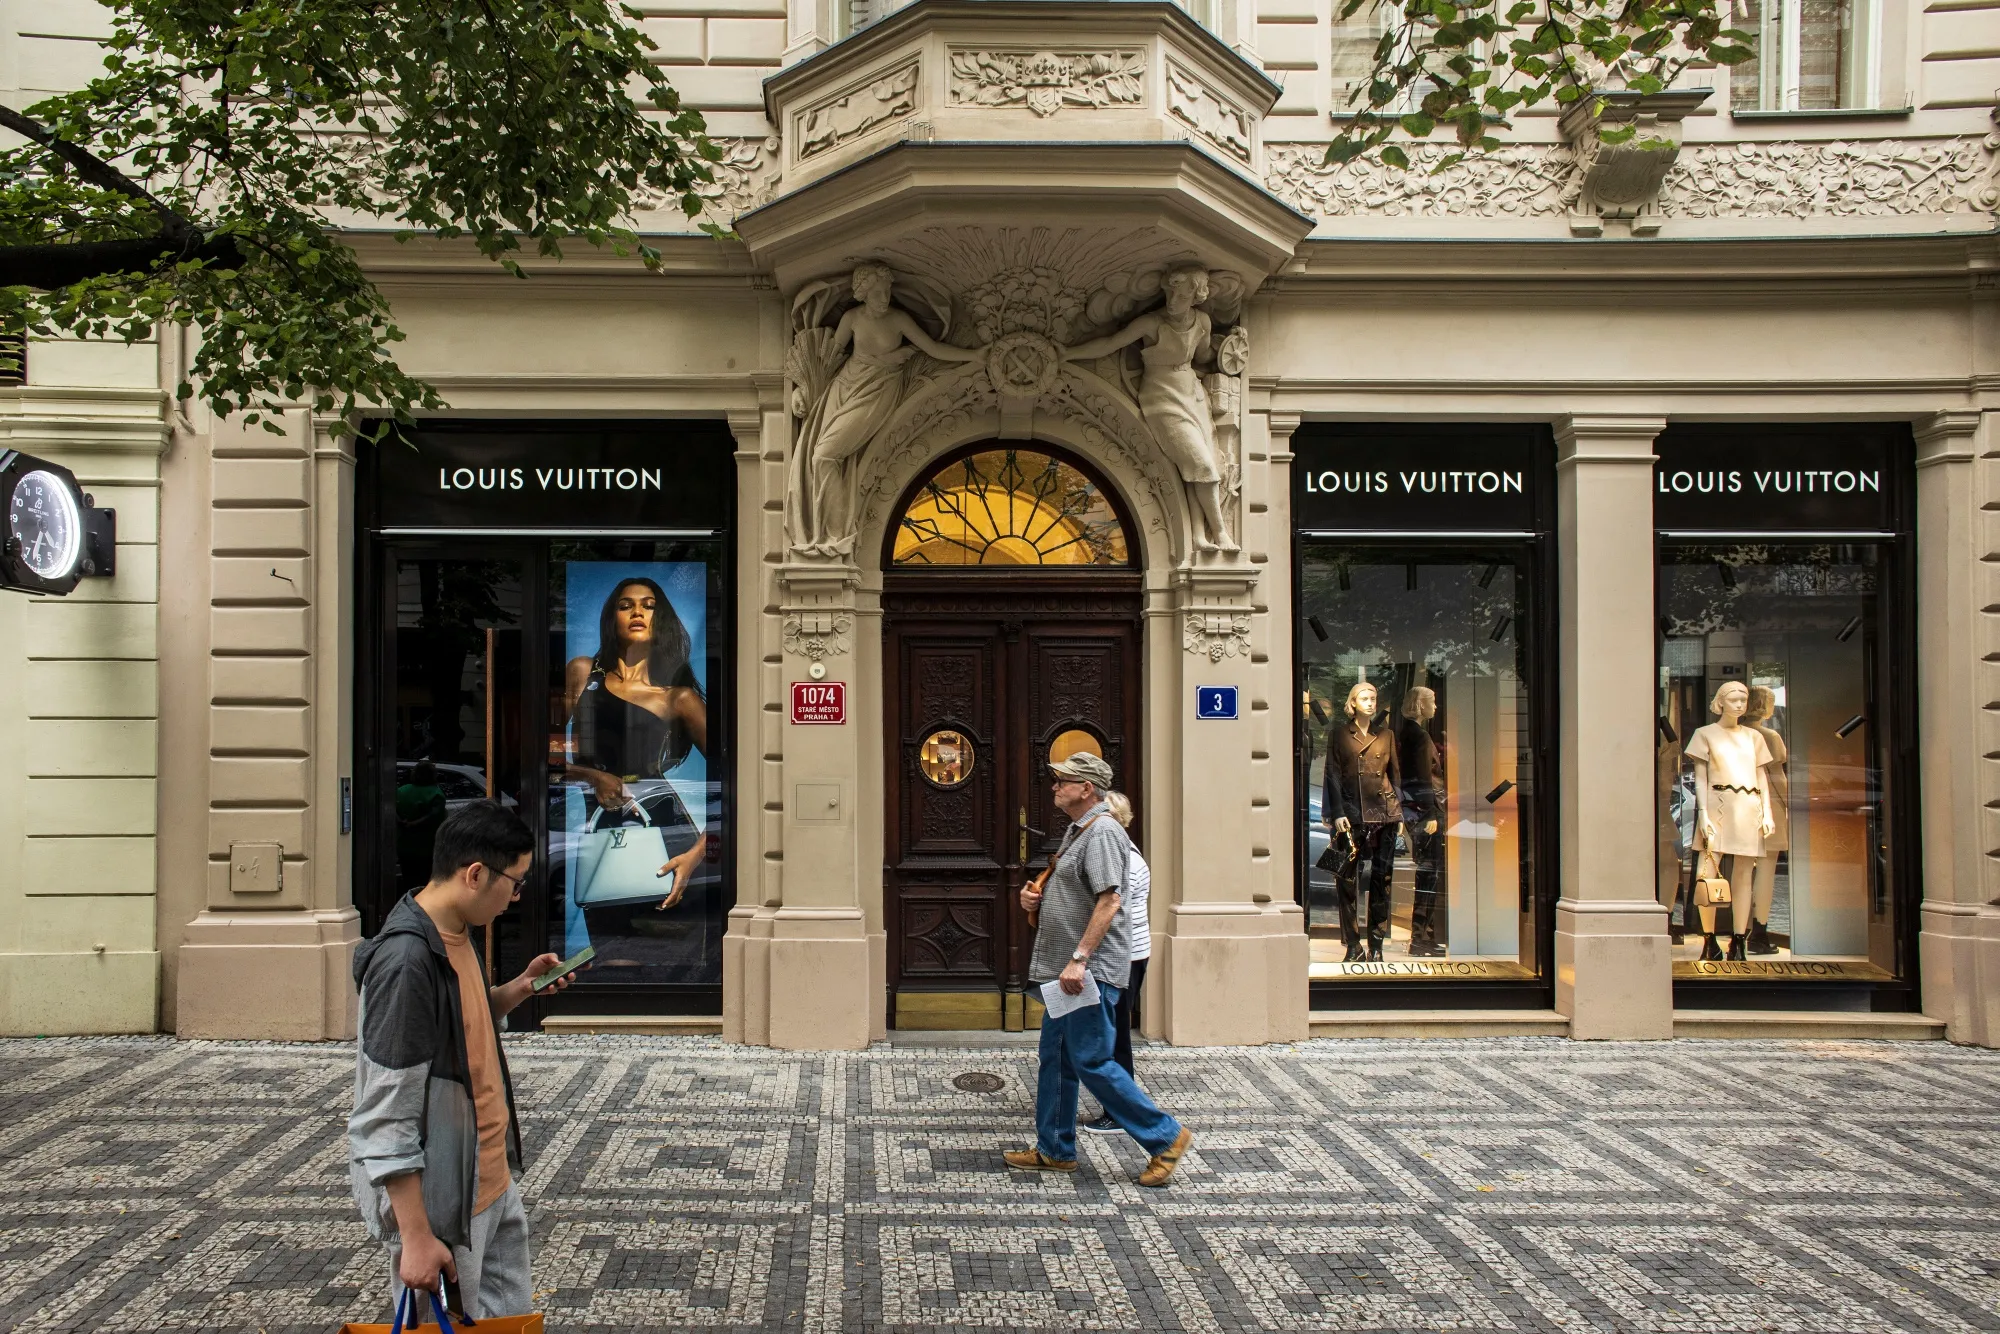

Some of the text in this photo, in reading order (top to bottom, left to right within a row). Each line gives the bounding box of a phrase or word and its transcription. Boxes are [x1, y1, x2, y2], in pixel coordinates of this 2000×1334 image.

[440, 468, 662, 491] LOUIS VUITTON
[1306, 471, 1523, 494] LOUIS VUITTON
[1659, 470, 1880, 494] LOUIS VUITTON
[25, 488, 31, 496] 11
[35, 486, 43, 496] 12
[16, 498, 24, 507] 10
[13, 514, 19, 523] 9
[25, 547, 31, 556] 7
[801, 688, 835, 704] 1074
[1214, 694, 1222, 711] 3
[1341, 963, 1489, 975] LOUIS VUITTON
[1692, 962, 1845, 975] LOUIS VUITTON
